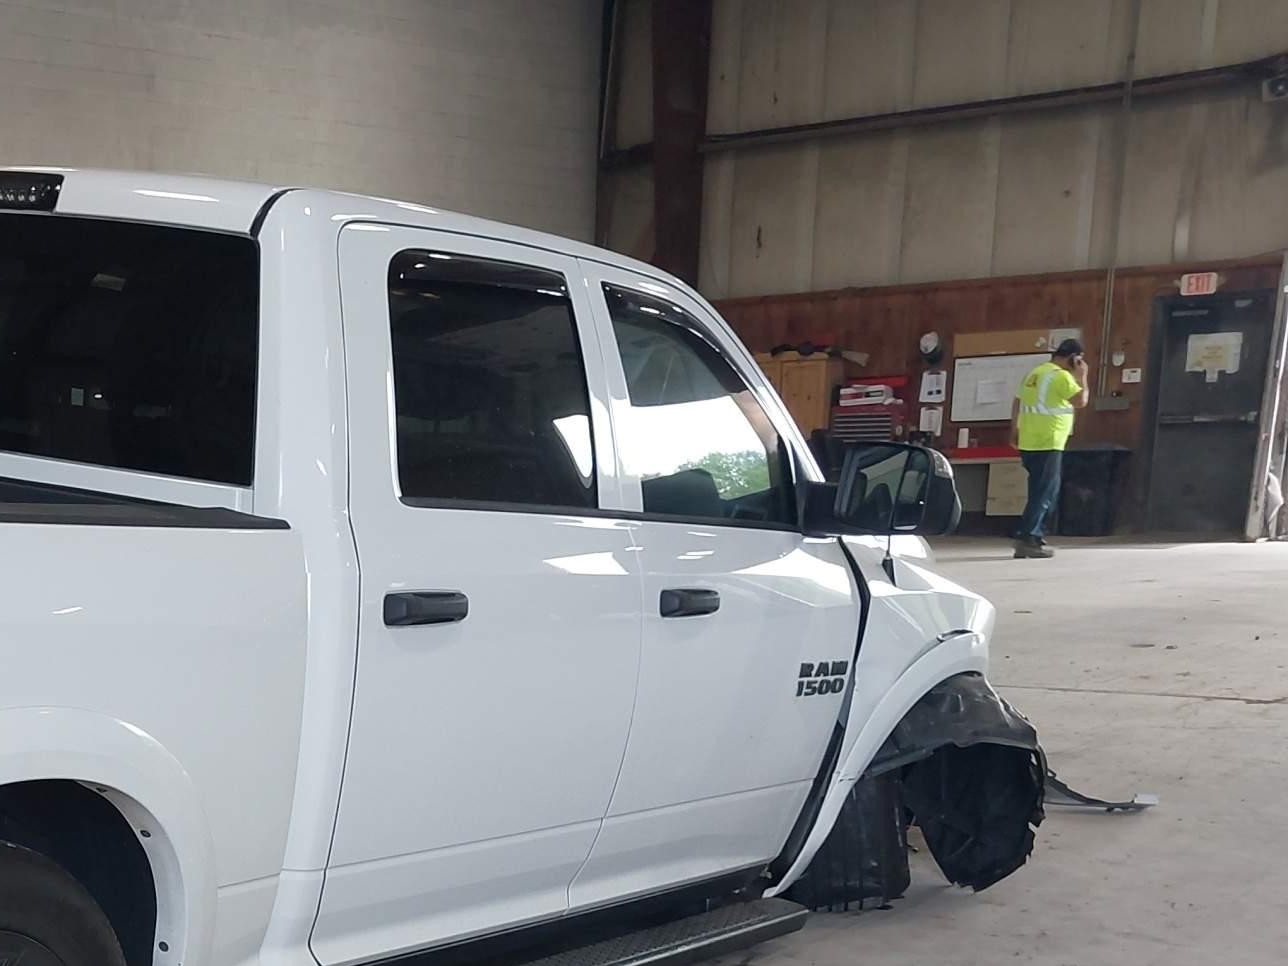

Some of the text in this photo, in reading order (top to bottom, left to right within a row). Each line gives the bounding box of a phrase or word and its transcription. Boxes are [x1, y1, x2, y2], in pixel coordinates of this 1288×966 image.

[1186, 274, 1211, 292] EXIT
[798, 660, 849, 678] RAM
[796, 678, 845, 697] 1500
